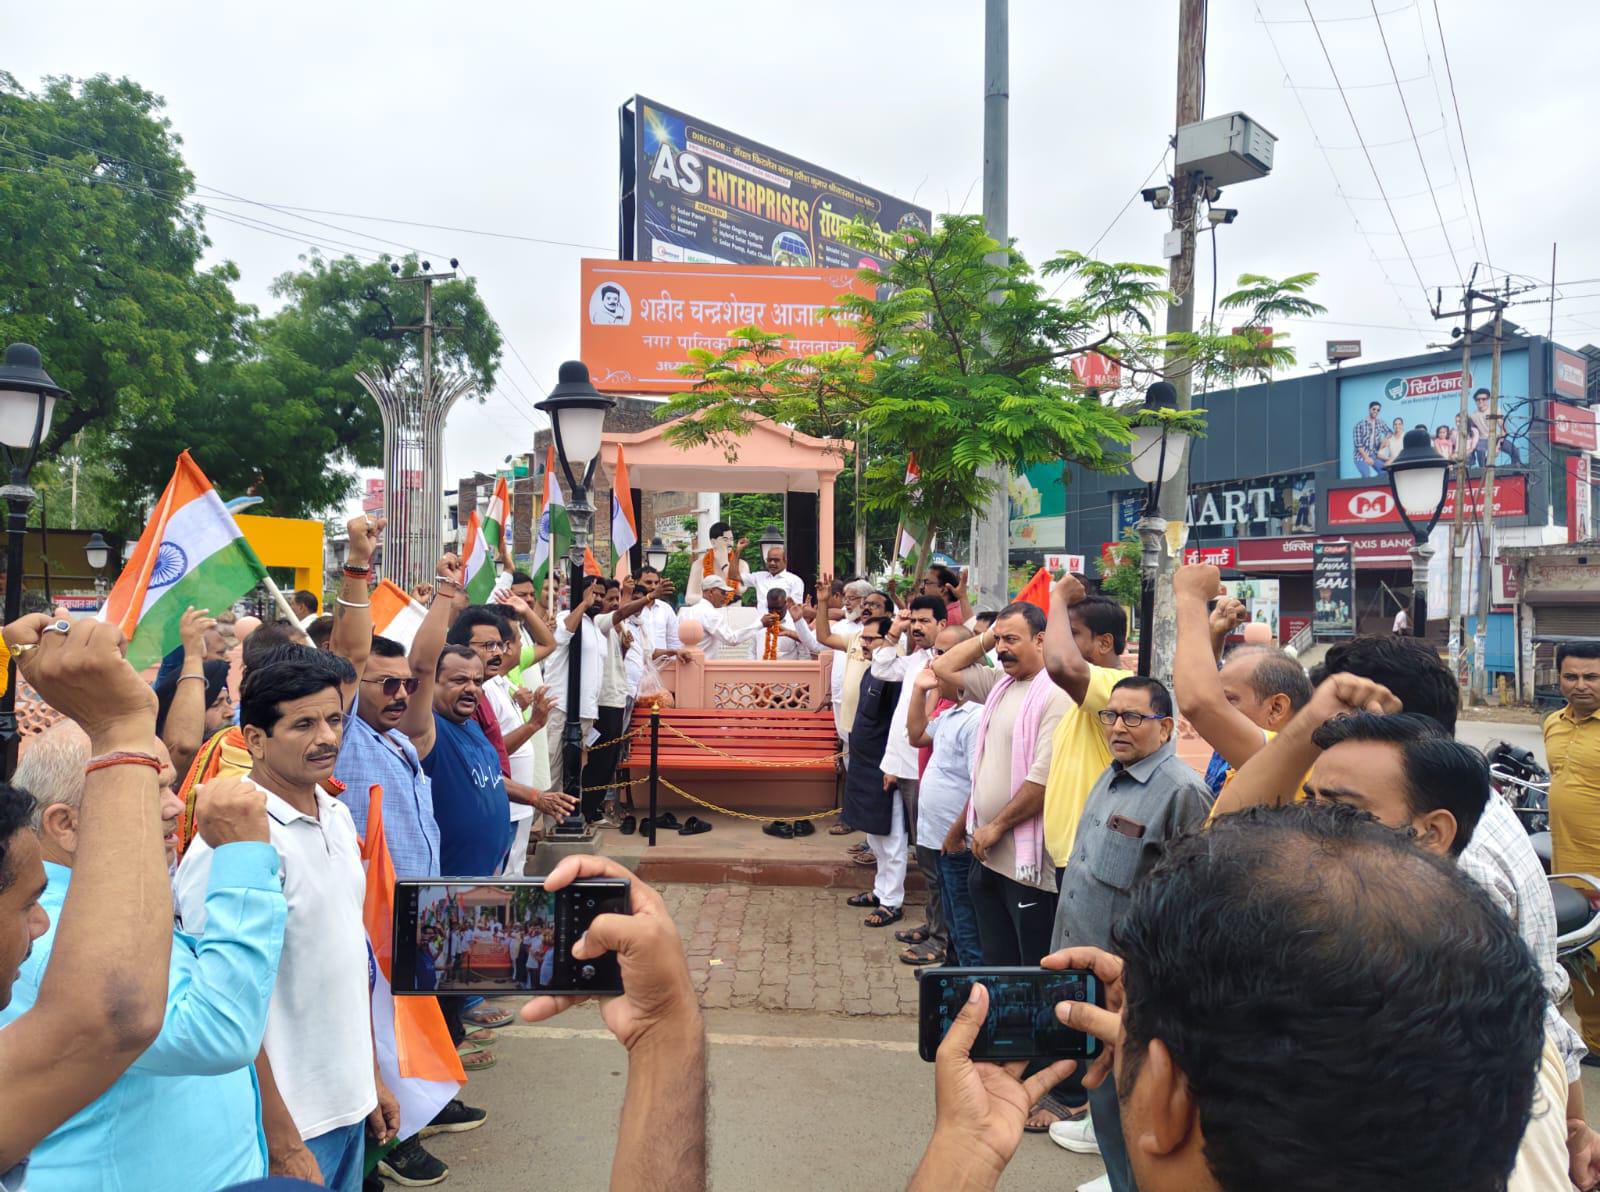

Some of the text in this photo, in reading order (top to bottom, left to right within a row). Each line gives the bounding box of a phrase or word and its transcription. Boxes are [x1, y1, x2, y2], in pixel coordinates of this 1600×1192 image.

[692, 131, 726, 150] DIRECTOR
[652, 143, 702, 194] AS
[707, 165, 810, 231] ENTERPRISES
[677, 207, 706, 221] Solar Panel
[640, 289, 685, 323] शहीद
[689, 292, 767, 327] चन्द्रशेखर
[641, 335, 673, 349] नगर
[676, 331, 733, 353] पालिका
[1354, 539, 1412, 549] AXIS BANK
[1315, 578, 1349, 589] SAAL
